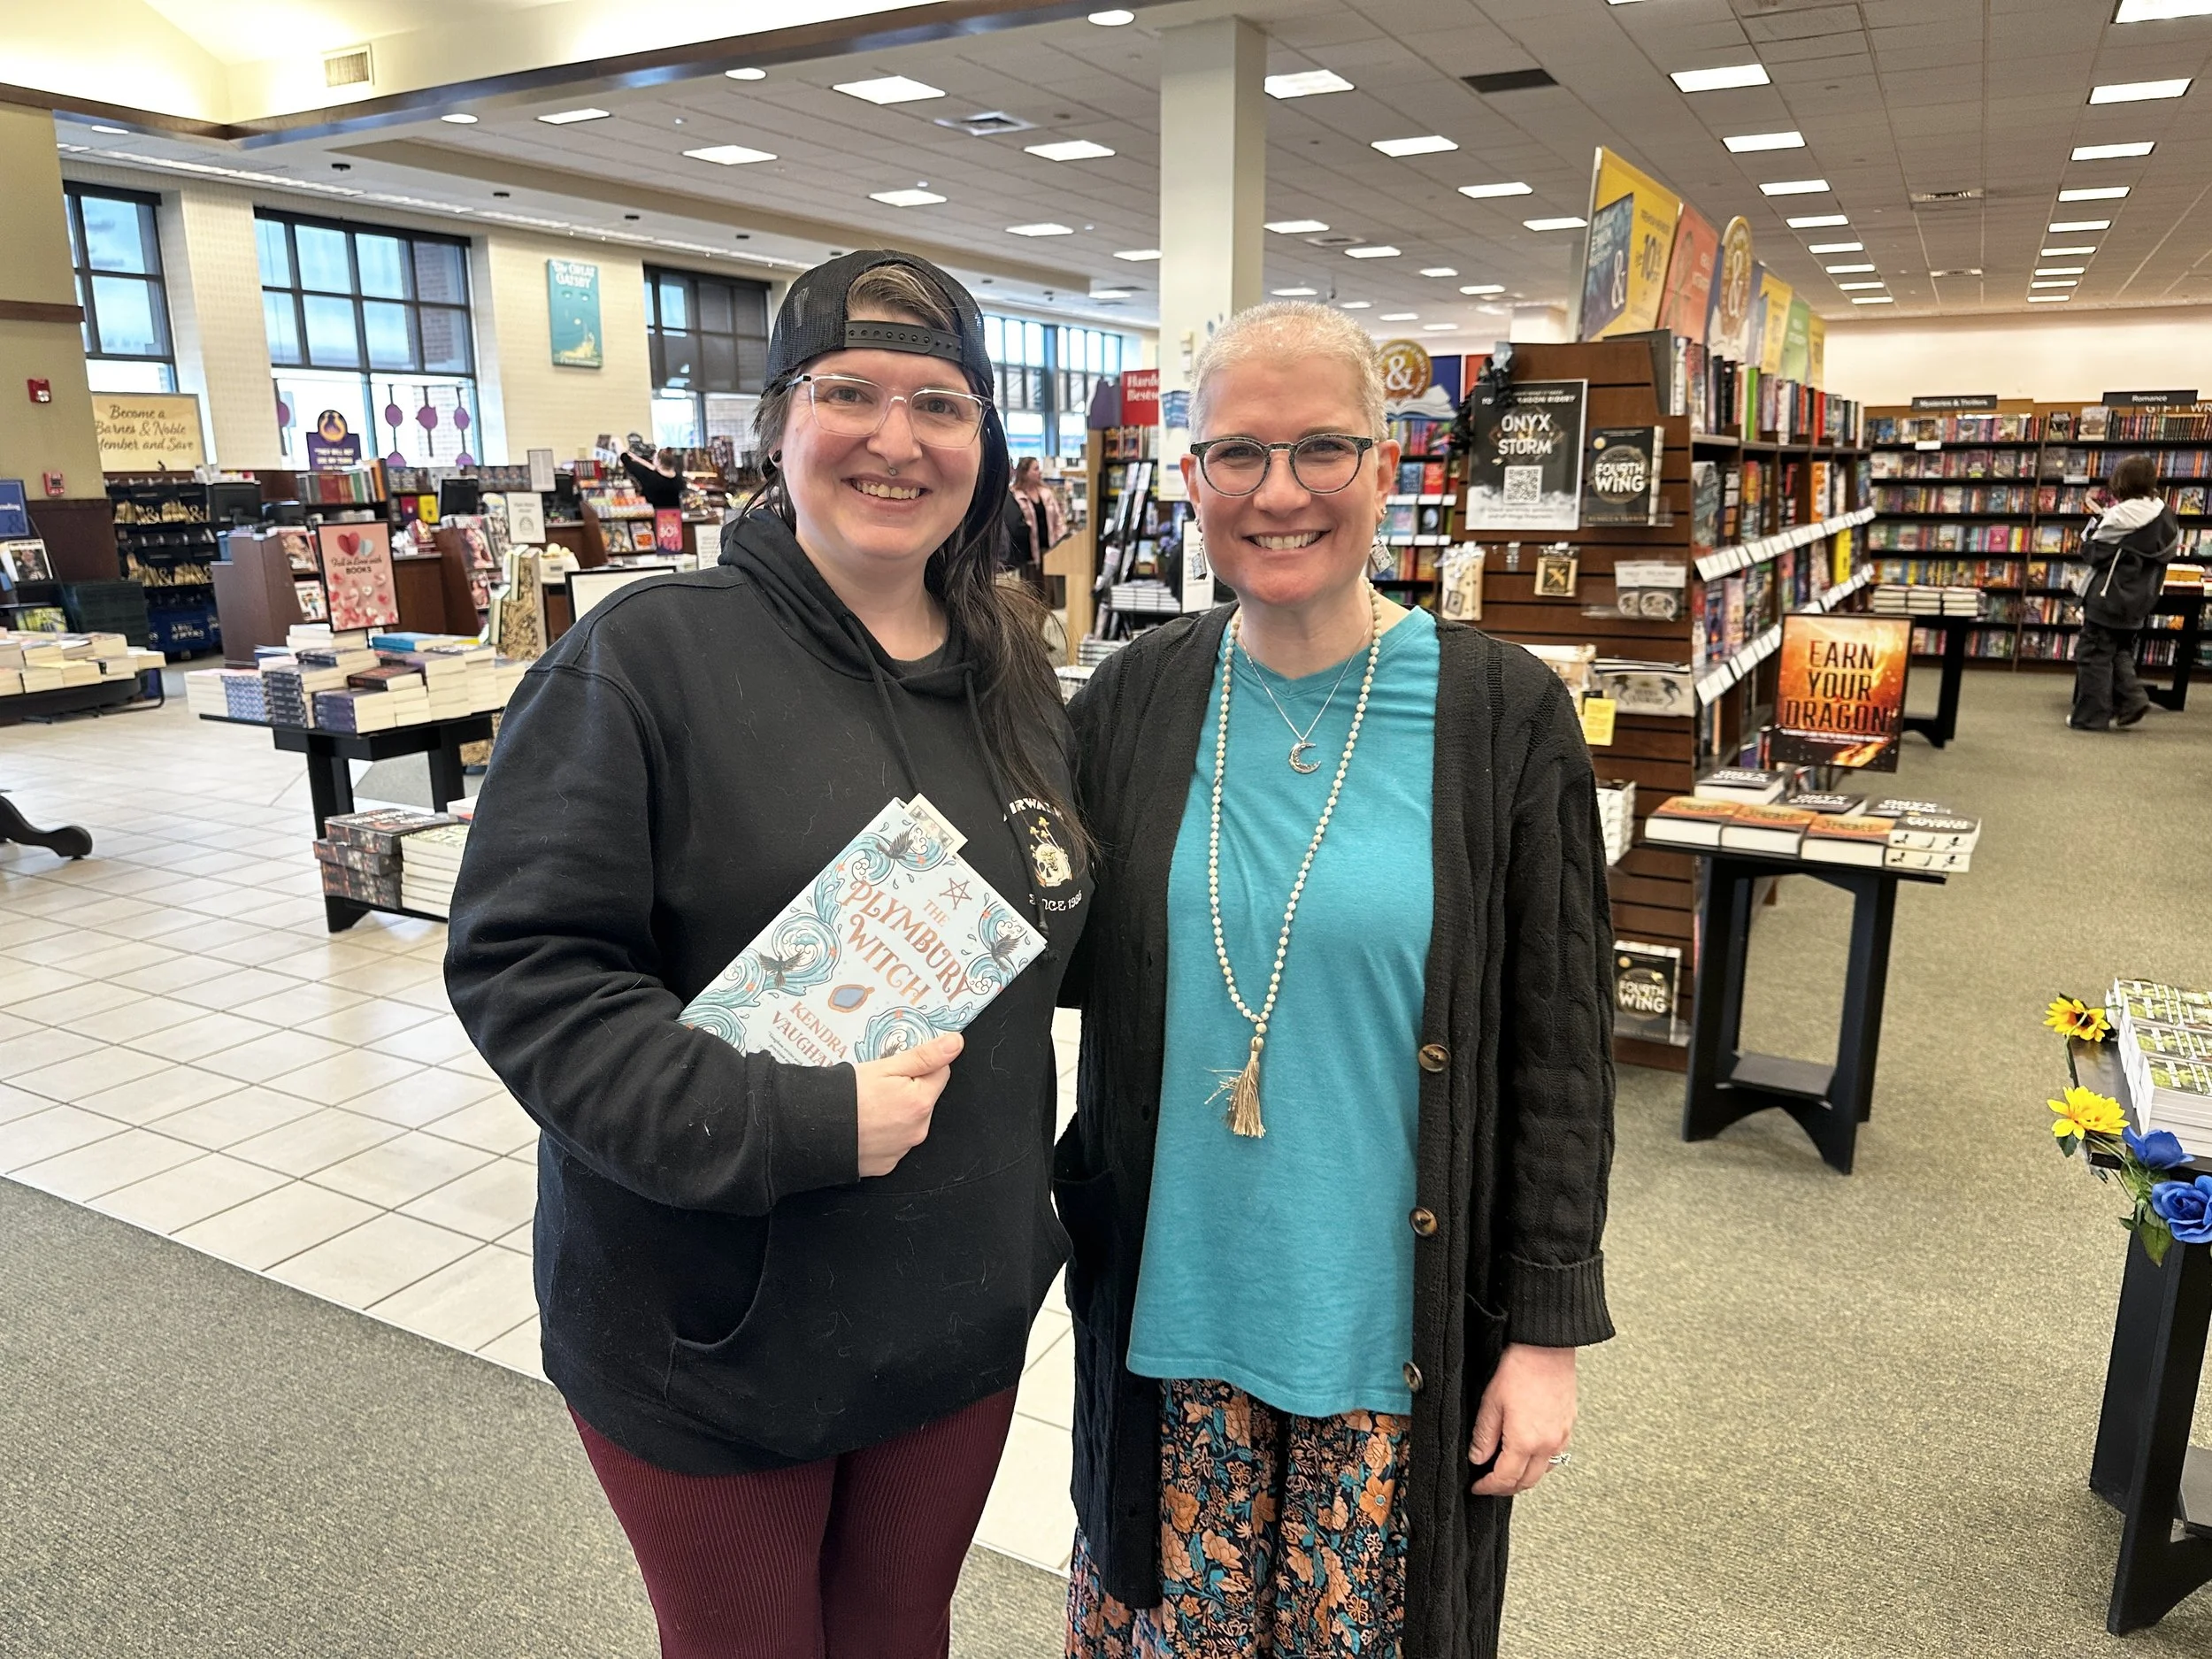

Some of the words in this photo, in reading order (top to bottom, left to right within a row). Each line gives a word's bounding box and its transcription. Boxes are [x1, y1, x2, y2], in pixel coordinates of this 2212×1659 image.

[109, 403, 156, 419] Become
[95, 420, 135, 435] Barnes
[139, 420, 150, 436] &
[153, 420, 186, 436] Noble
[1502, 413, 1552, 432] ONYX
[142, 438, 165, 450] and
[166, 437, 194, 451] Save
[1498, 438, 1553, 455] STORM
[1594, 462, 1645, 477] FOURTH
[1594, 474, 1646, 493] WING
[346, 566, 372, 575] BOOKS
[1809, 640, 1875, 670] EARN
[1807, 669, 1872, 702] YOUR
[1785, 699, 1888, 733] DRAGON
[1720, 769, 1769, 779] ONYX
[1028, 893, 1067, 911] SNCE
[922, 899, 950, 928] THE
[841, 879, 972, 1002] PLYMBURY
[847, 913, 932, 1006] WITCH
[1618, 979, 1665, 997] FOURTH
[1617, 991, 1668, 1014] WING
[772, 1010, 834, 1067] VAUGHA
[789, 1001, 849, 1060] KENDRA
